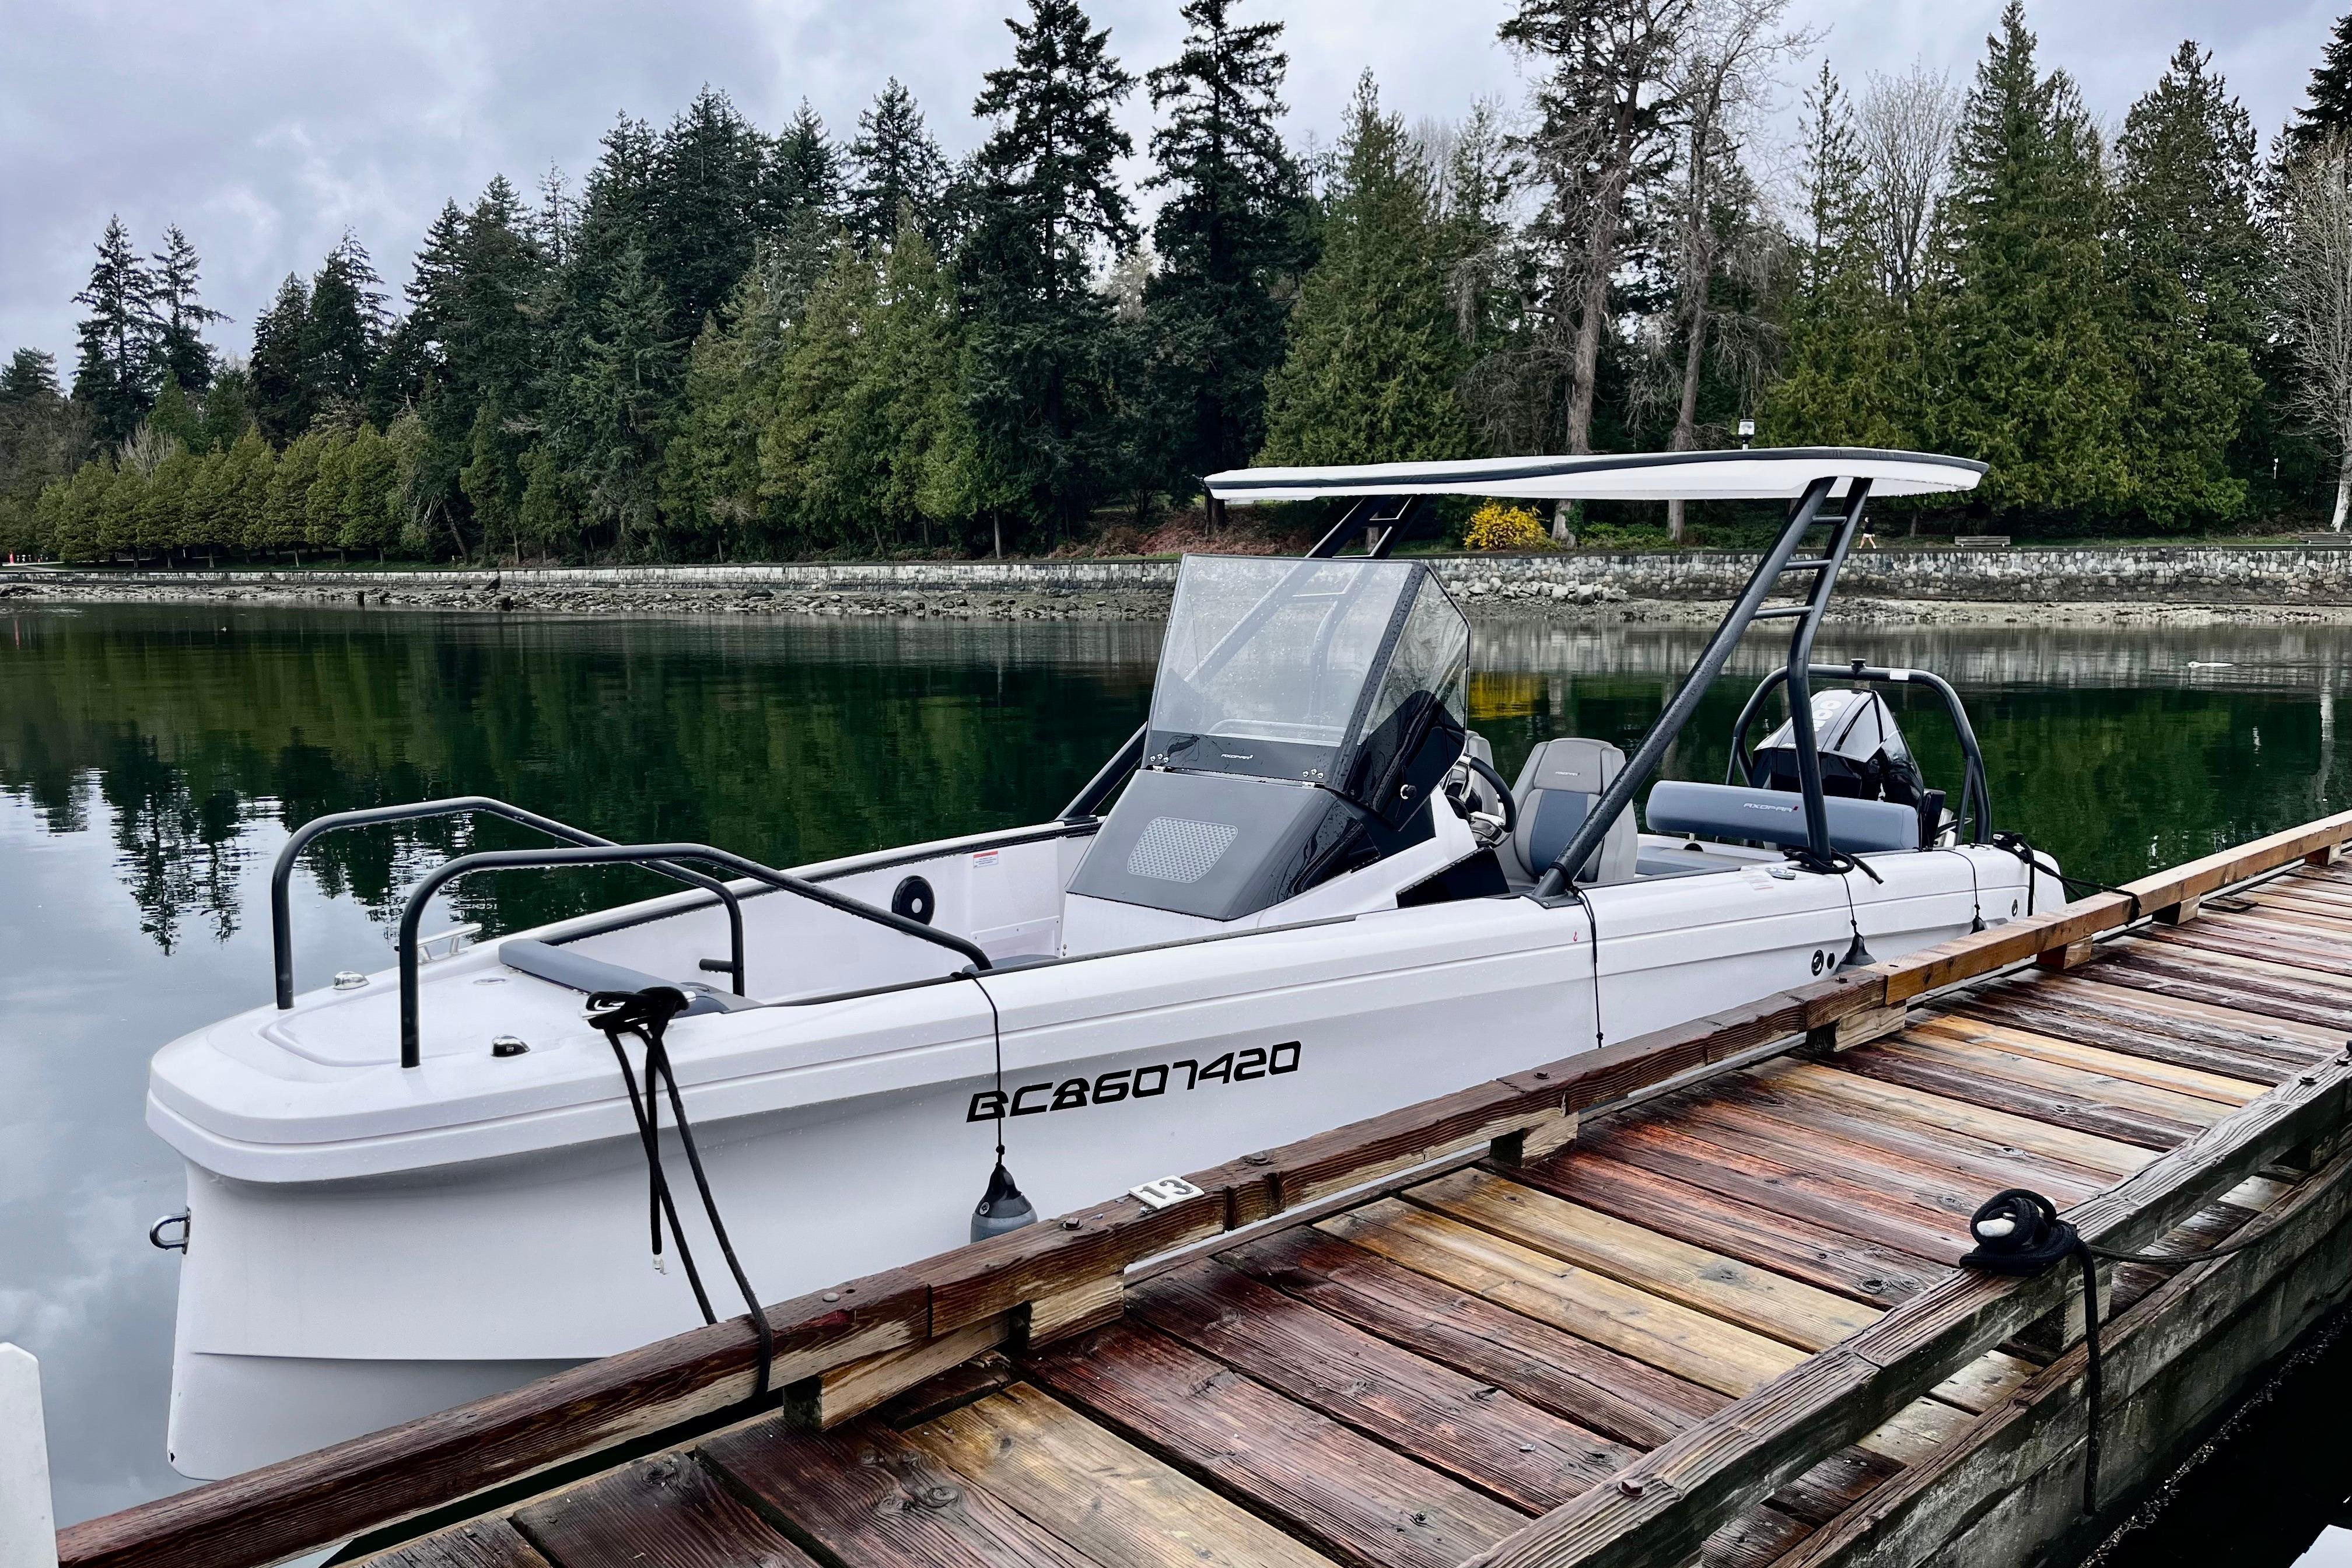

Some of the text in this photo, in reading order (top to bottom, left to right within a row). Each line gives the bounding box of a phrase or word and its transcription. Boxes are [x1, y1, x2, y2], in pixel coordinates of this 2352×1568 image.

[1744, 803, 1792, 813] AXOPAR
[966, 1040, 1301, 1123] BC8607420
[1138, 1179, 1194, 1200] 13
